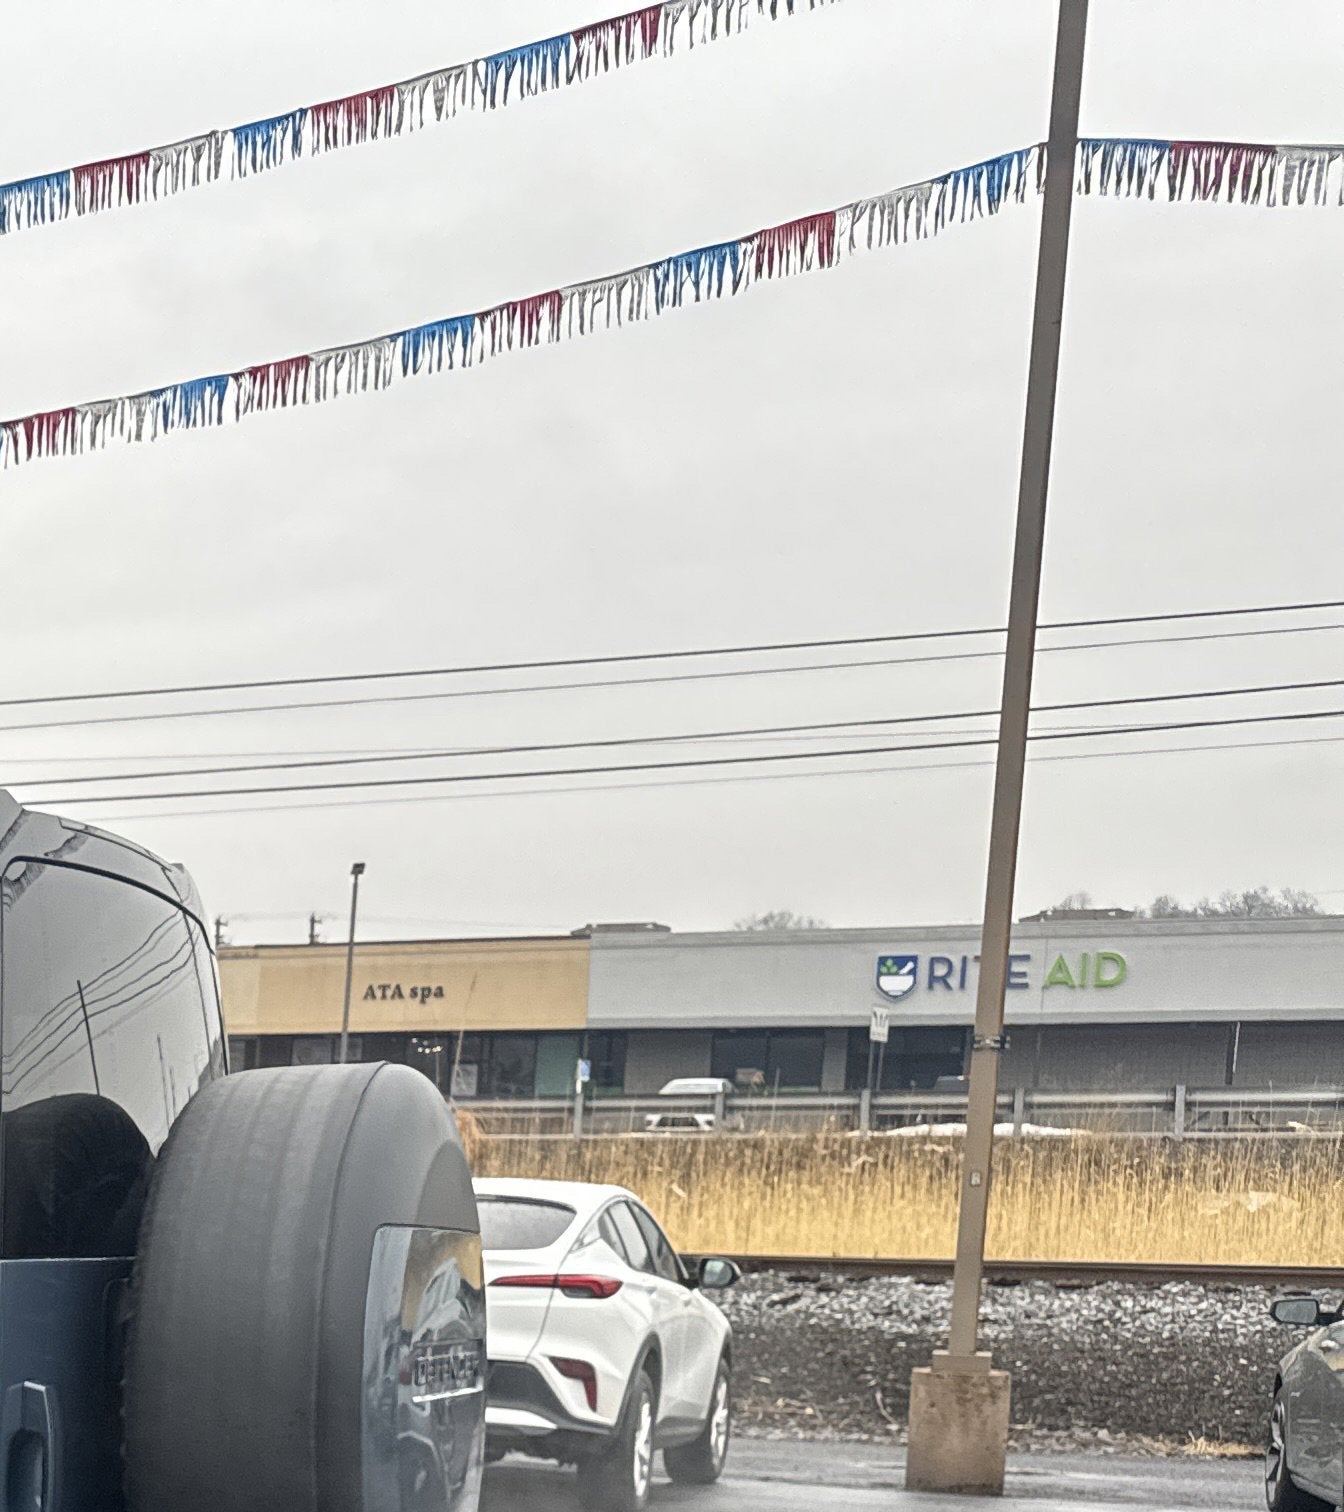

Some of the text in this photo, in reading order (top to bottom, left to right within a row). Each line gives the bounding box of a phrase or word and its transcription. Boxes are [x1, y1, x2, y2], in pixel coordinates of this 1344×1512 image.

[927, 951, 1127, 991] RIE AID
[363, 984, 444, 1005] ATA spa
